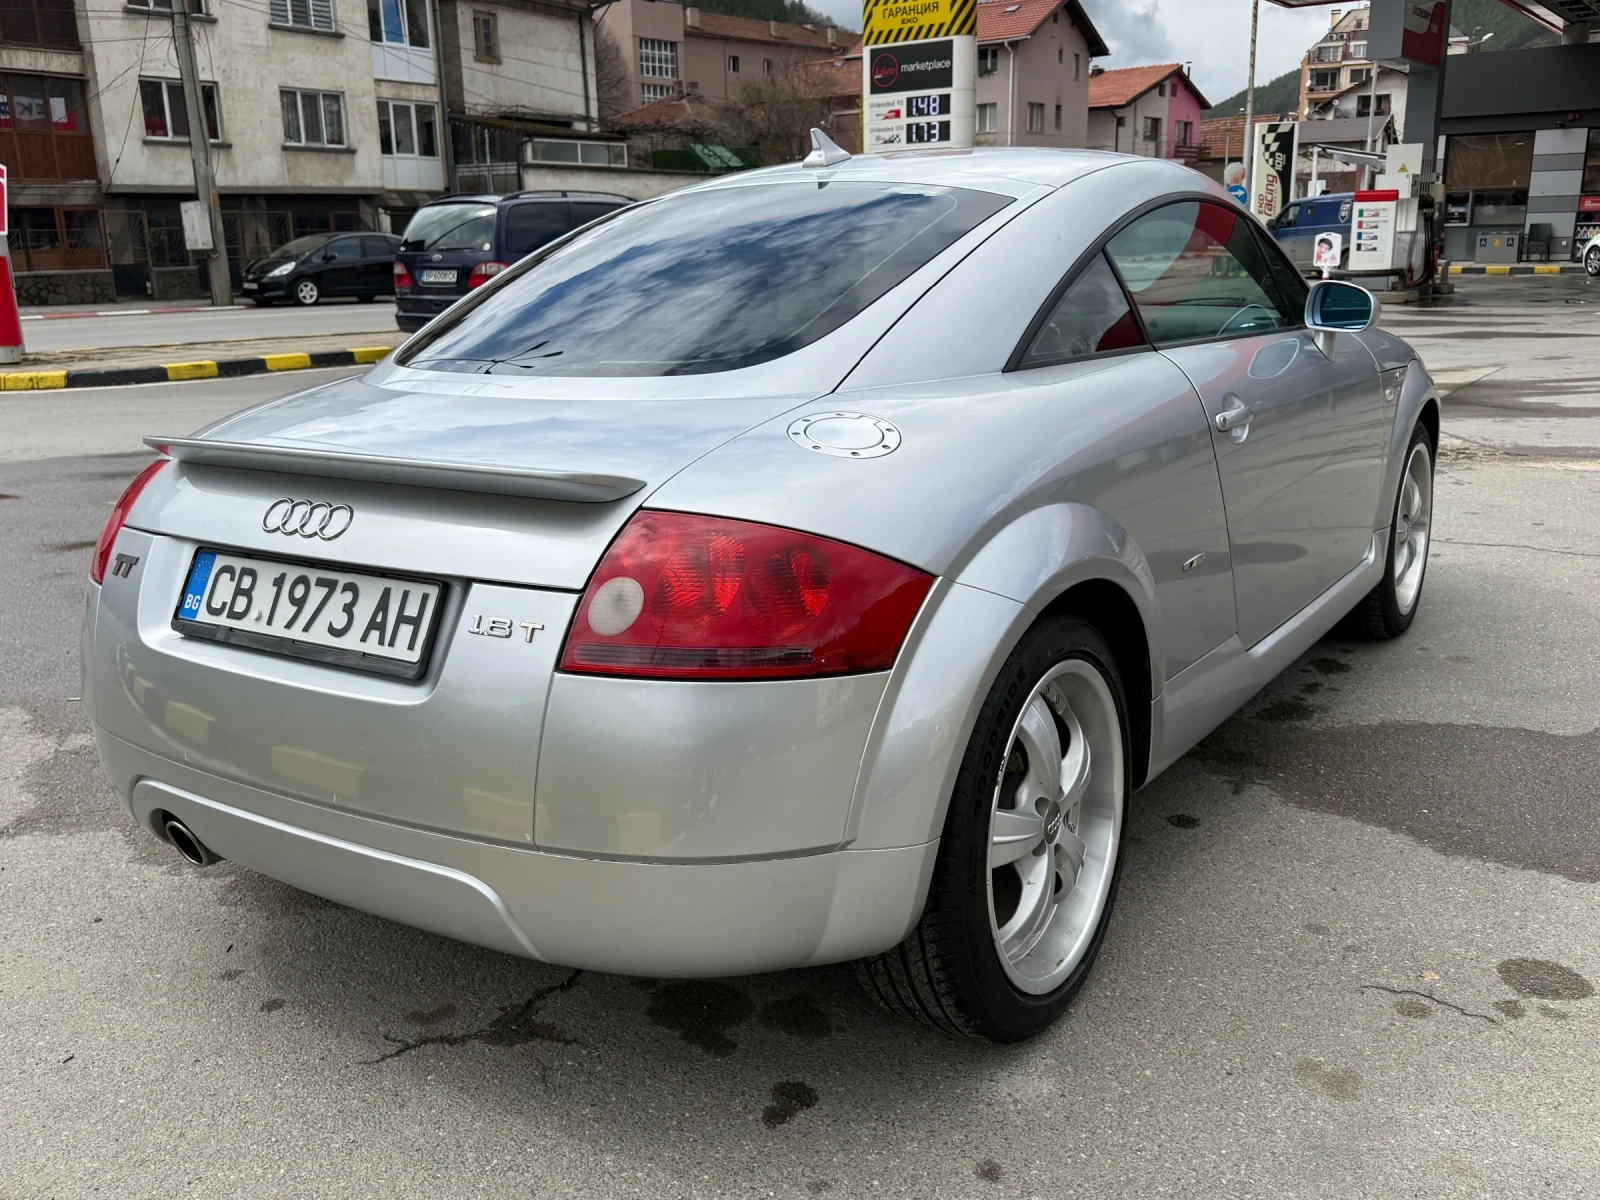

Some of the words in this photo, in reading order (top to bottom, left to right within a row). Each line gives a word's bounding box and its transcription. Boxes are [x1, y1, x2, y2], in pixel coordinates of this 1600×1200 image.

[882, 1, 939, 19] ГАРАНЦИЯ
[900, 59, 951, 73] marketplace
[869, 99, 895, 109] Unleaded
[869, 125, 894, 134] Unleaded
[1275, 152, 1283, 171] 100
[1257, 194, 1265, 215] EKO
[1264, 174, 1278, 217] racing
[112, 553, 140, 578] TT
[184, 594, 201, 610] BG
[206, 564, 257, 621] CB
[266, 572, 360, 638] 1973
[360, 586, 430, 651] AH
[519, 621, 545, 643] T
